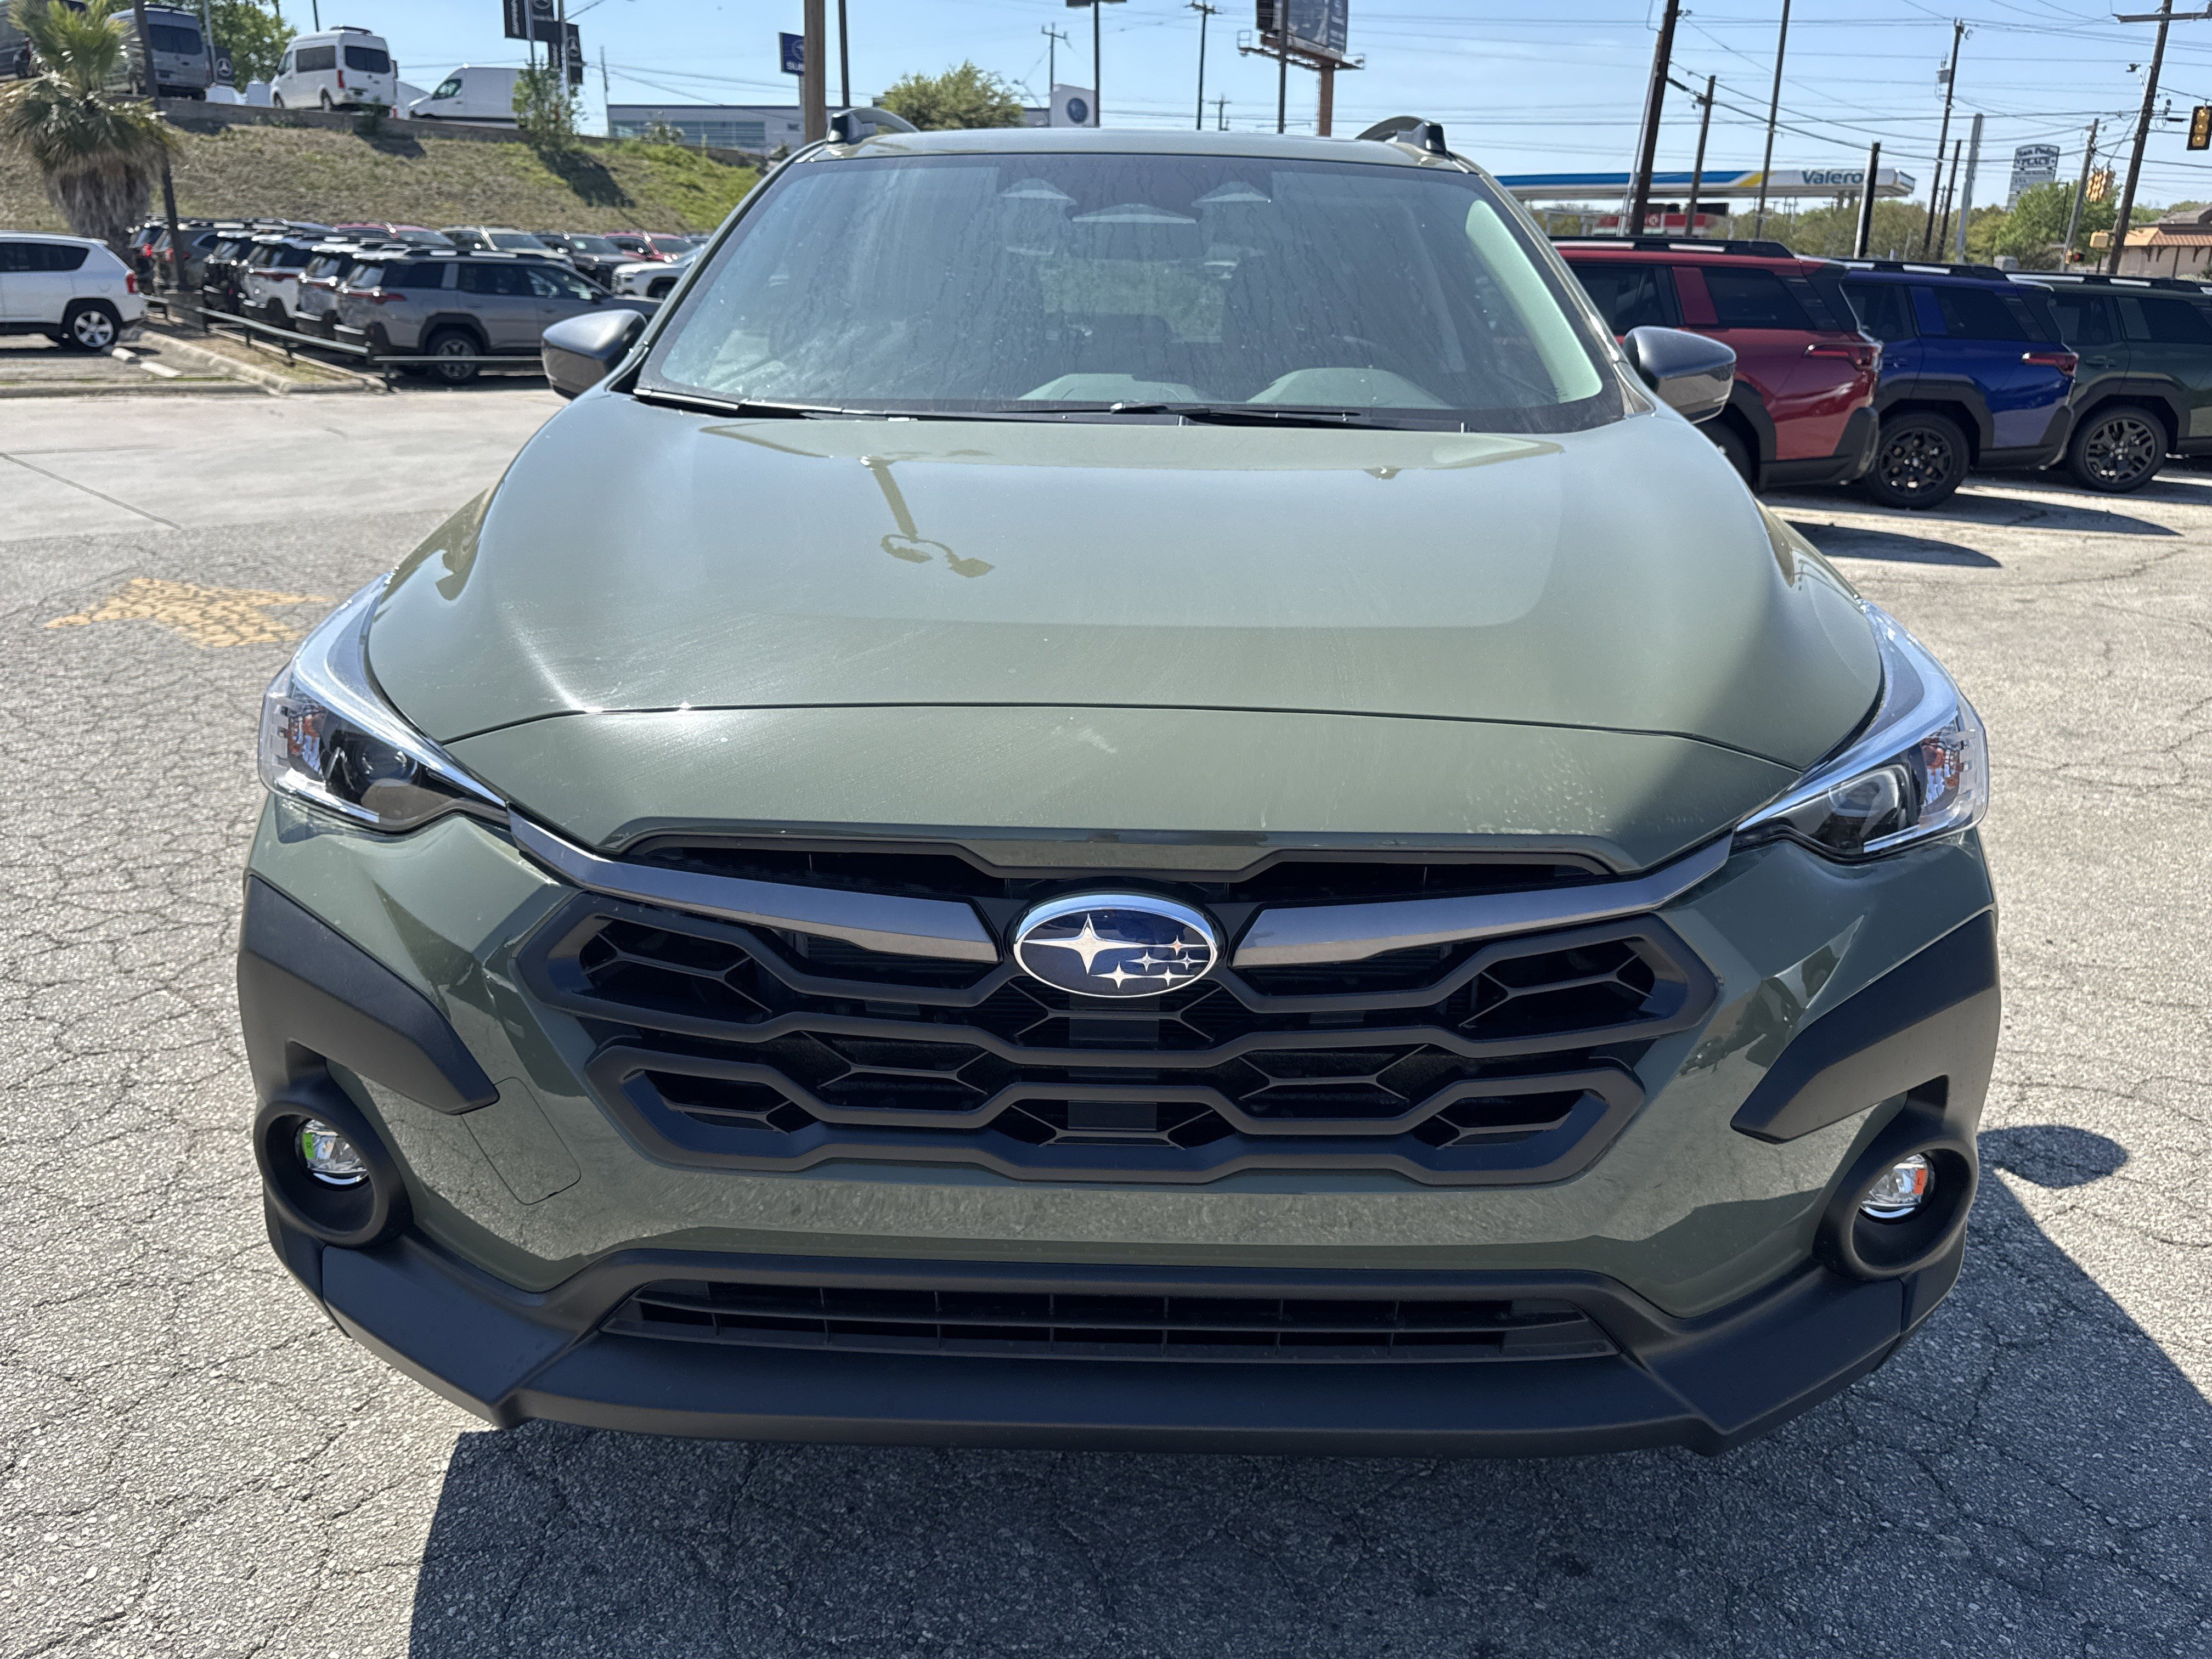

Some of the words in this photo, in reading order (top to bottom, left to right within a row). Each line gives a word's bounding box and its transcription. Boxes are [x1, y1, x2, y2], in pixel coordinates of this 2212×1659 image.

[1802, 171, 1864, 184] Valero
[306, 1142, 312, 1150] R
[1917, 1177, 1922, 1186] L
